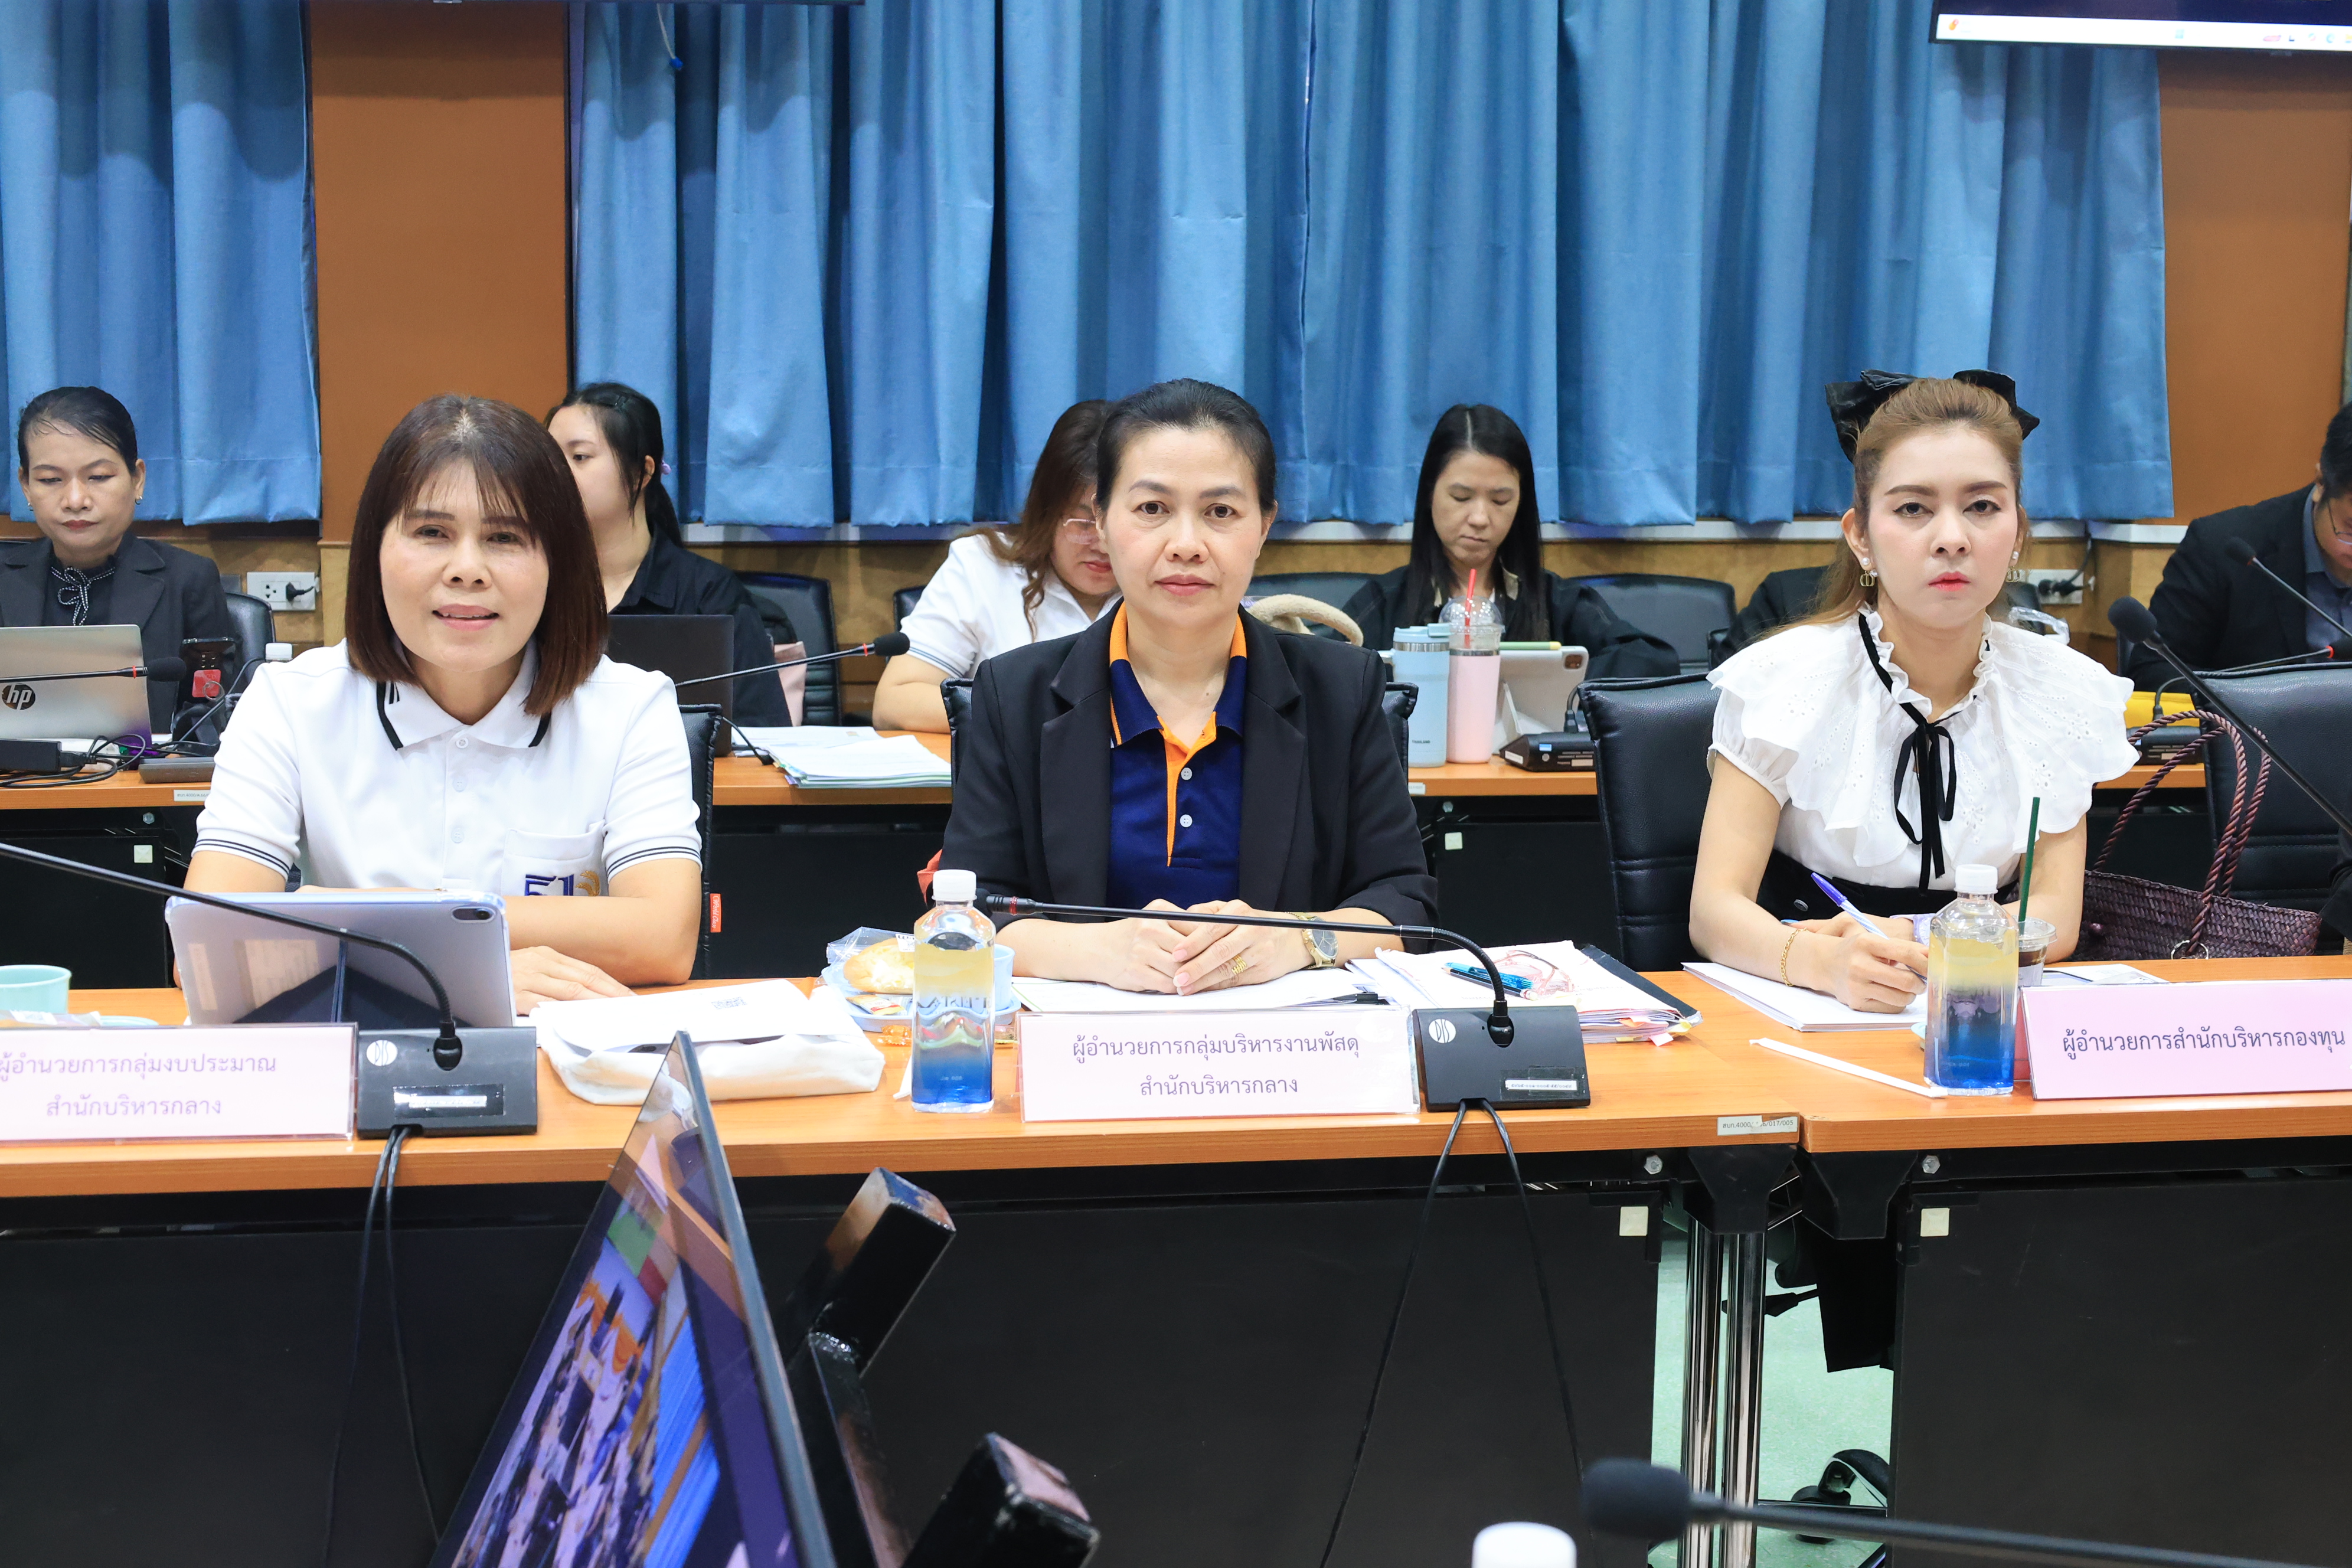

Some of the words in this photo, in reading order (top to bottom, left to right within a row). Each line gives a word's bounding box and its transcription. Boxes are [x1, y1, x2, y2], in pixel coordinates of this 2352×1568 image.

[6, 684, 32, 710] hp
[1073, 1030, 1359, 1064] ผู้อำนวยการกลุ่มบริหารงานพัสดุ
[2063, 1025, 2346, 1060] ผู้อำนวยการสำนักบริหารกองทุน
[0, 1051, 276, 1082] ผู้อำนวยการกลุ่มงบประมาณ
[1140, 1074, 1298, 1096] สำนักบริหารกลาง
[47, 1093, 221, 1116] สำนักบริหารกลาง
